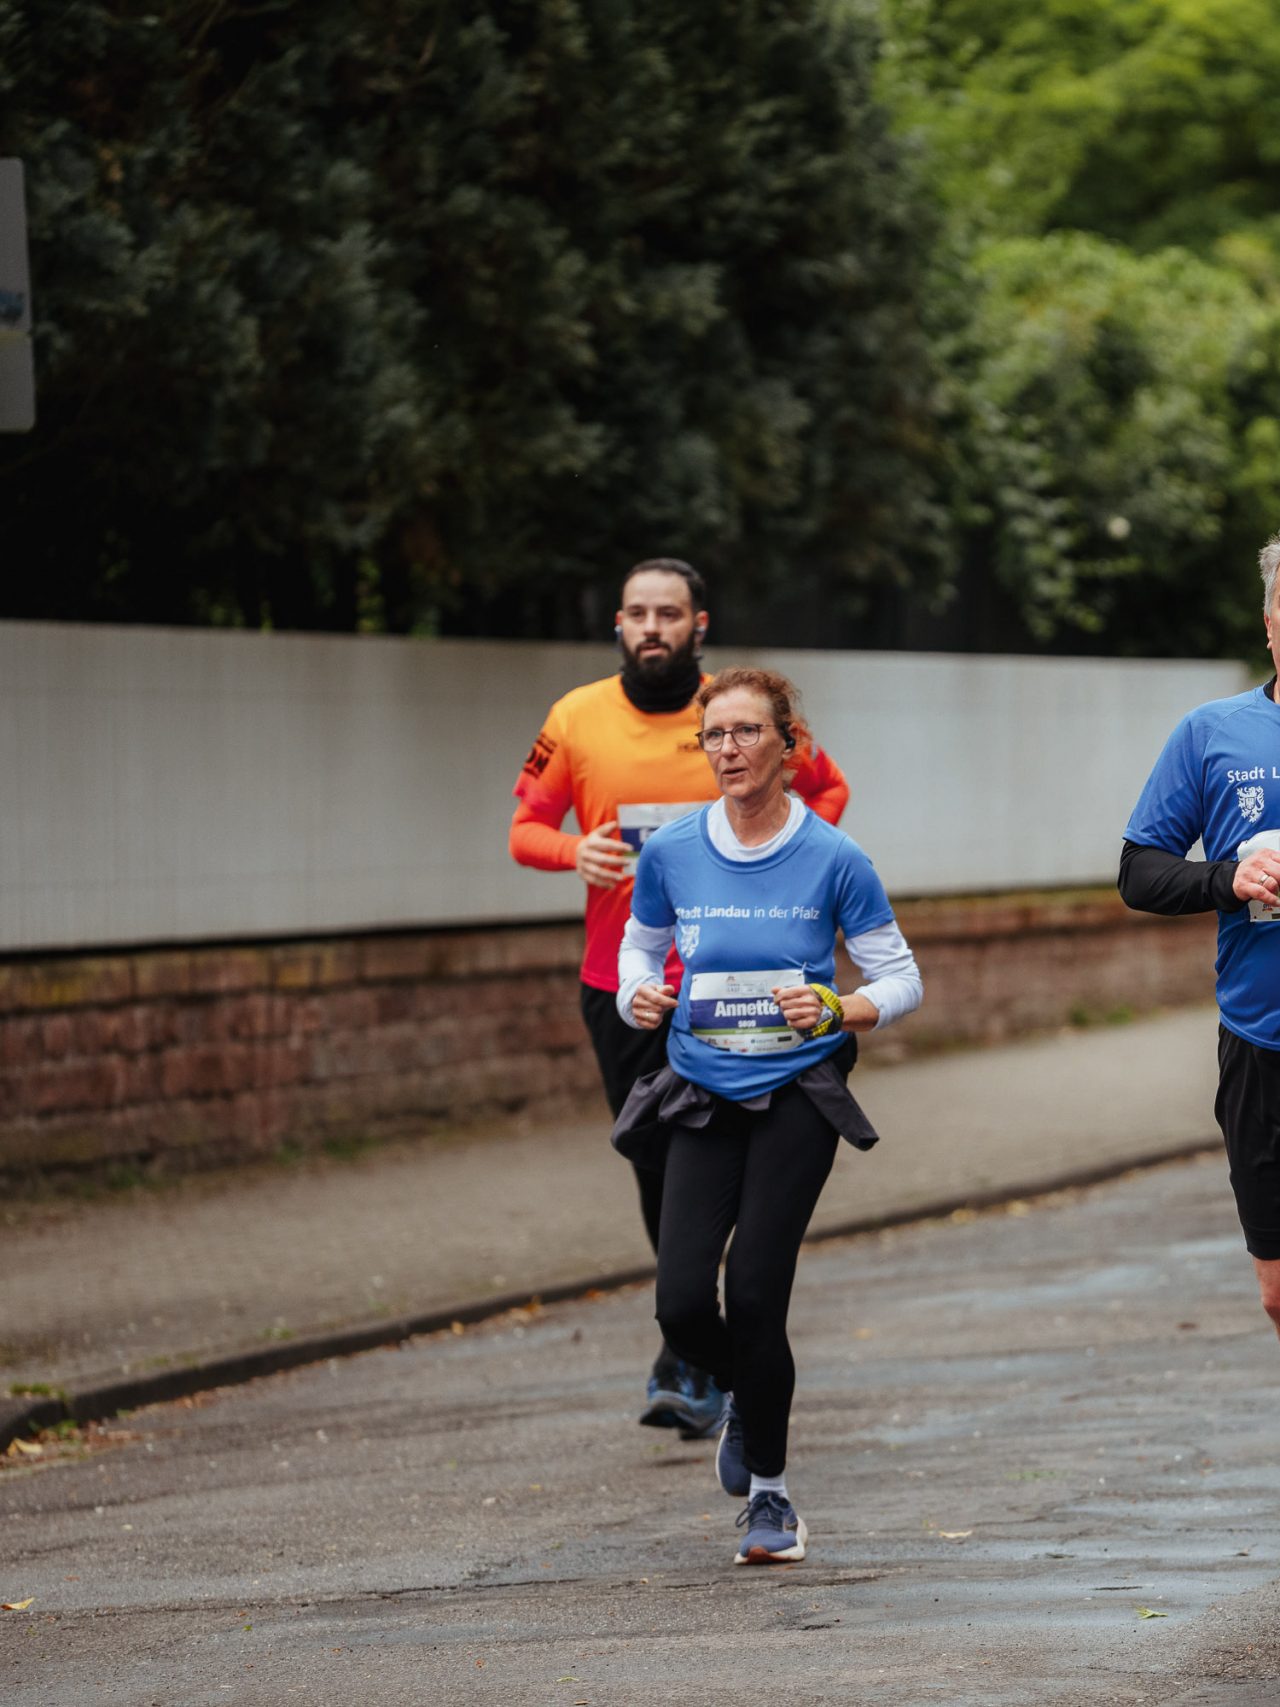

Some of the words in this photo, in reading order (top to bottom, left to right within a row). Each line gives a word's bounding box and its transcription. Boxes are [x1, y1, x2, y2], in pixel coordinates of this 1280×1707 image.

[1227, 766, 1265, 783] Stadt
[675, 906, 701, 919] Stadt
[705, 905, 750, 918] Landau
[754, 905, 765, 918] in
[769, 905, 789, 918] der
[792, 905, 820, 919] Pfalz
[714, 1000, 779, 1017] Annette
